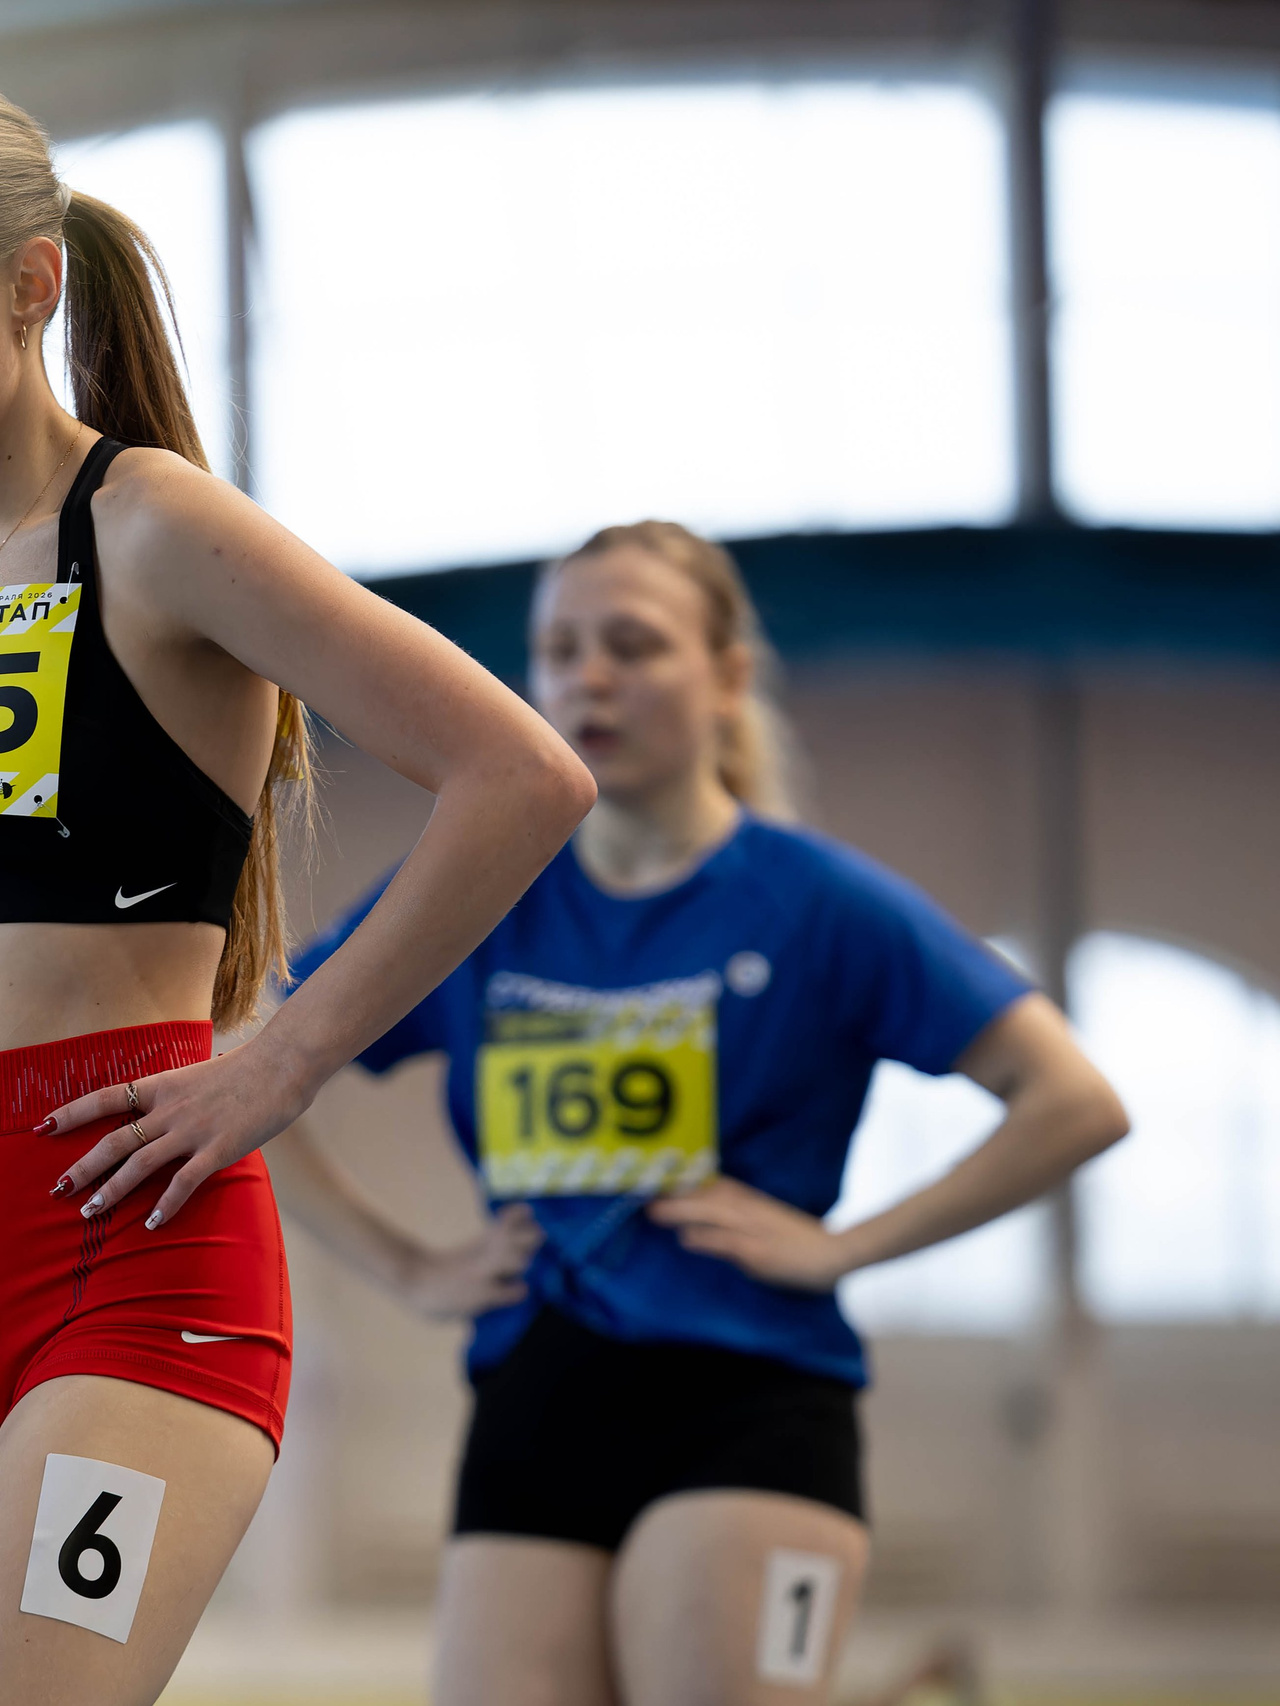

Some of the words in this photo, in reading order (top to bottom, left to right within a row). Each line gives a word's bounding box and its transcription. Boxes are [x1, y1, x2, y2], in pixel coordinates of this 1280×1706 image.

[28, 592, 53, 600] 2026
[508, 1060, 675, 1138] 169
[58, 1490, 123, 1600] 6
[787, 1577, 815, 1664] 1
